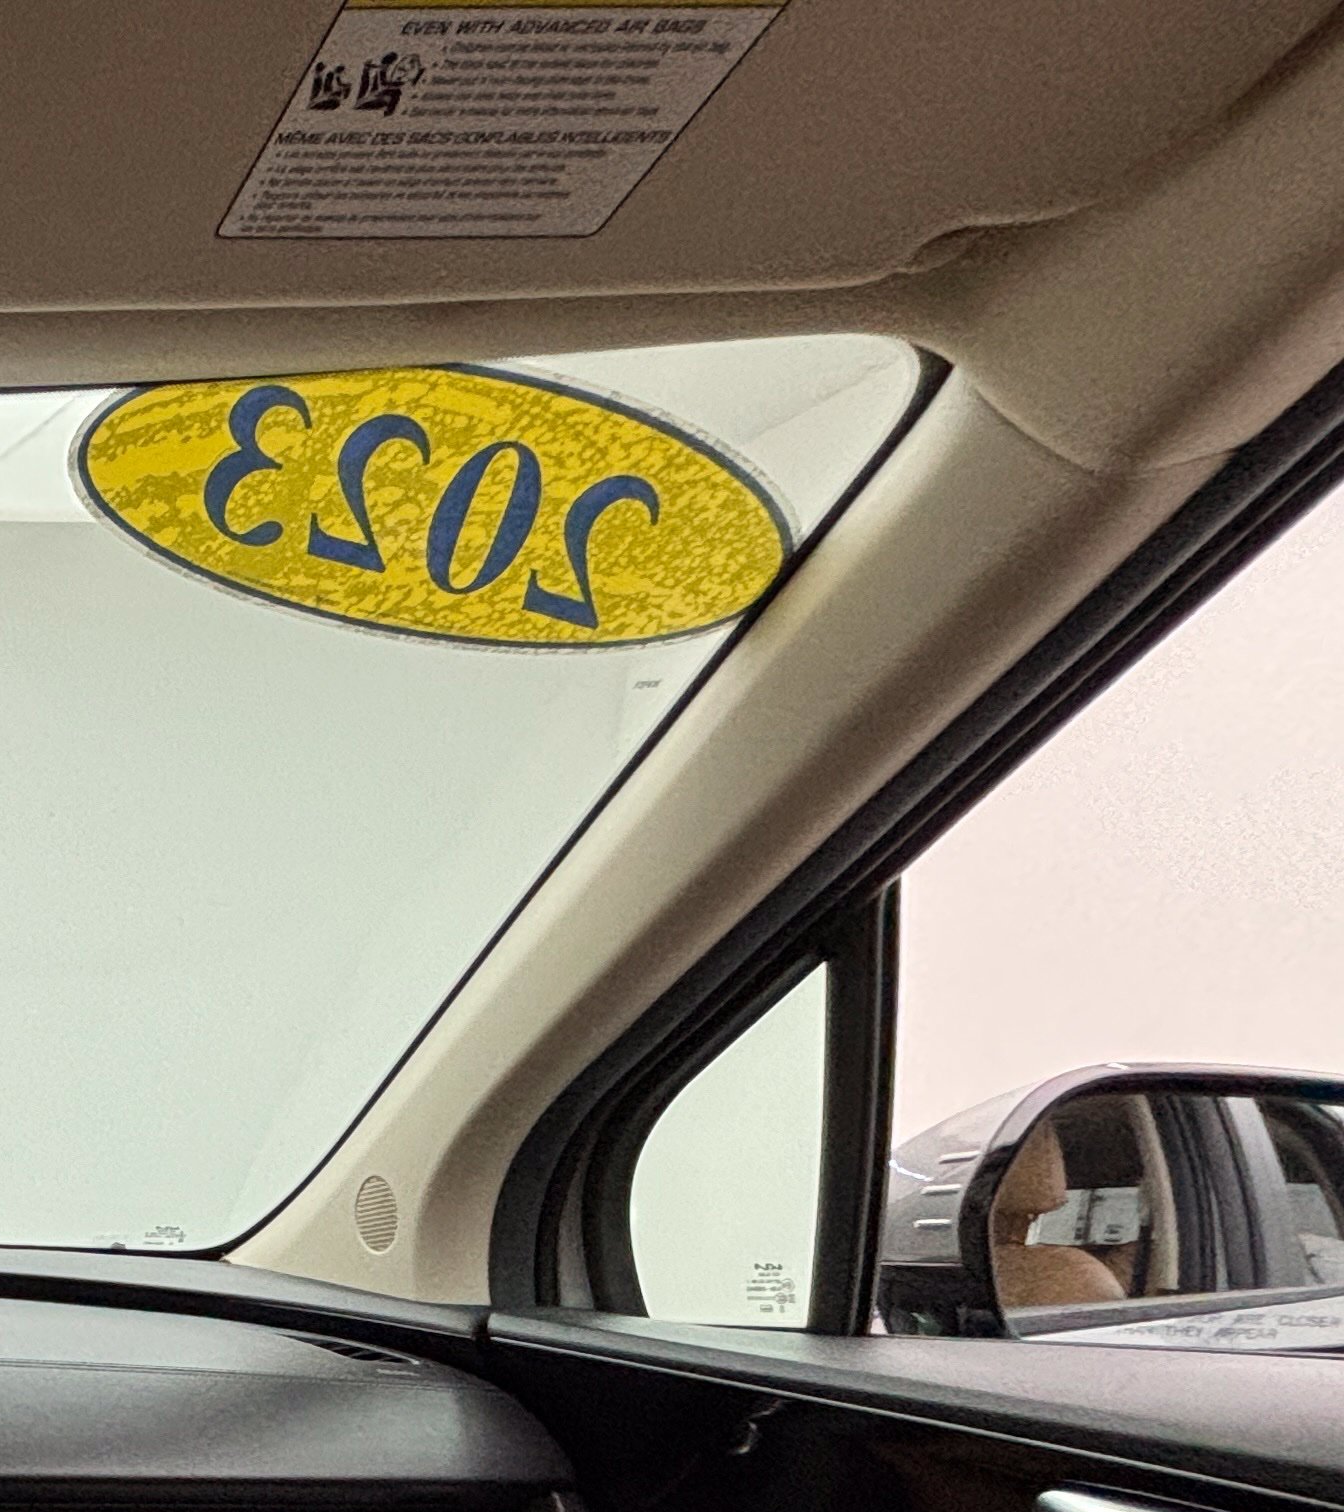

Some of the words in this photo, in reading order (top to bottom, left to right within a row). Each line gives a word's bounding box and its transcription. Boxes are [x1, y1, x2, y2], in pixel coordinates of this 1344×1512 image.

[400, 20, 450, 35] EVEN
[456, 20, 503, 35] WITH
[509, 20, 611, 35] ADVANCED
